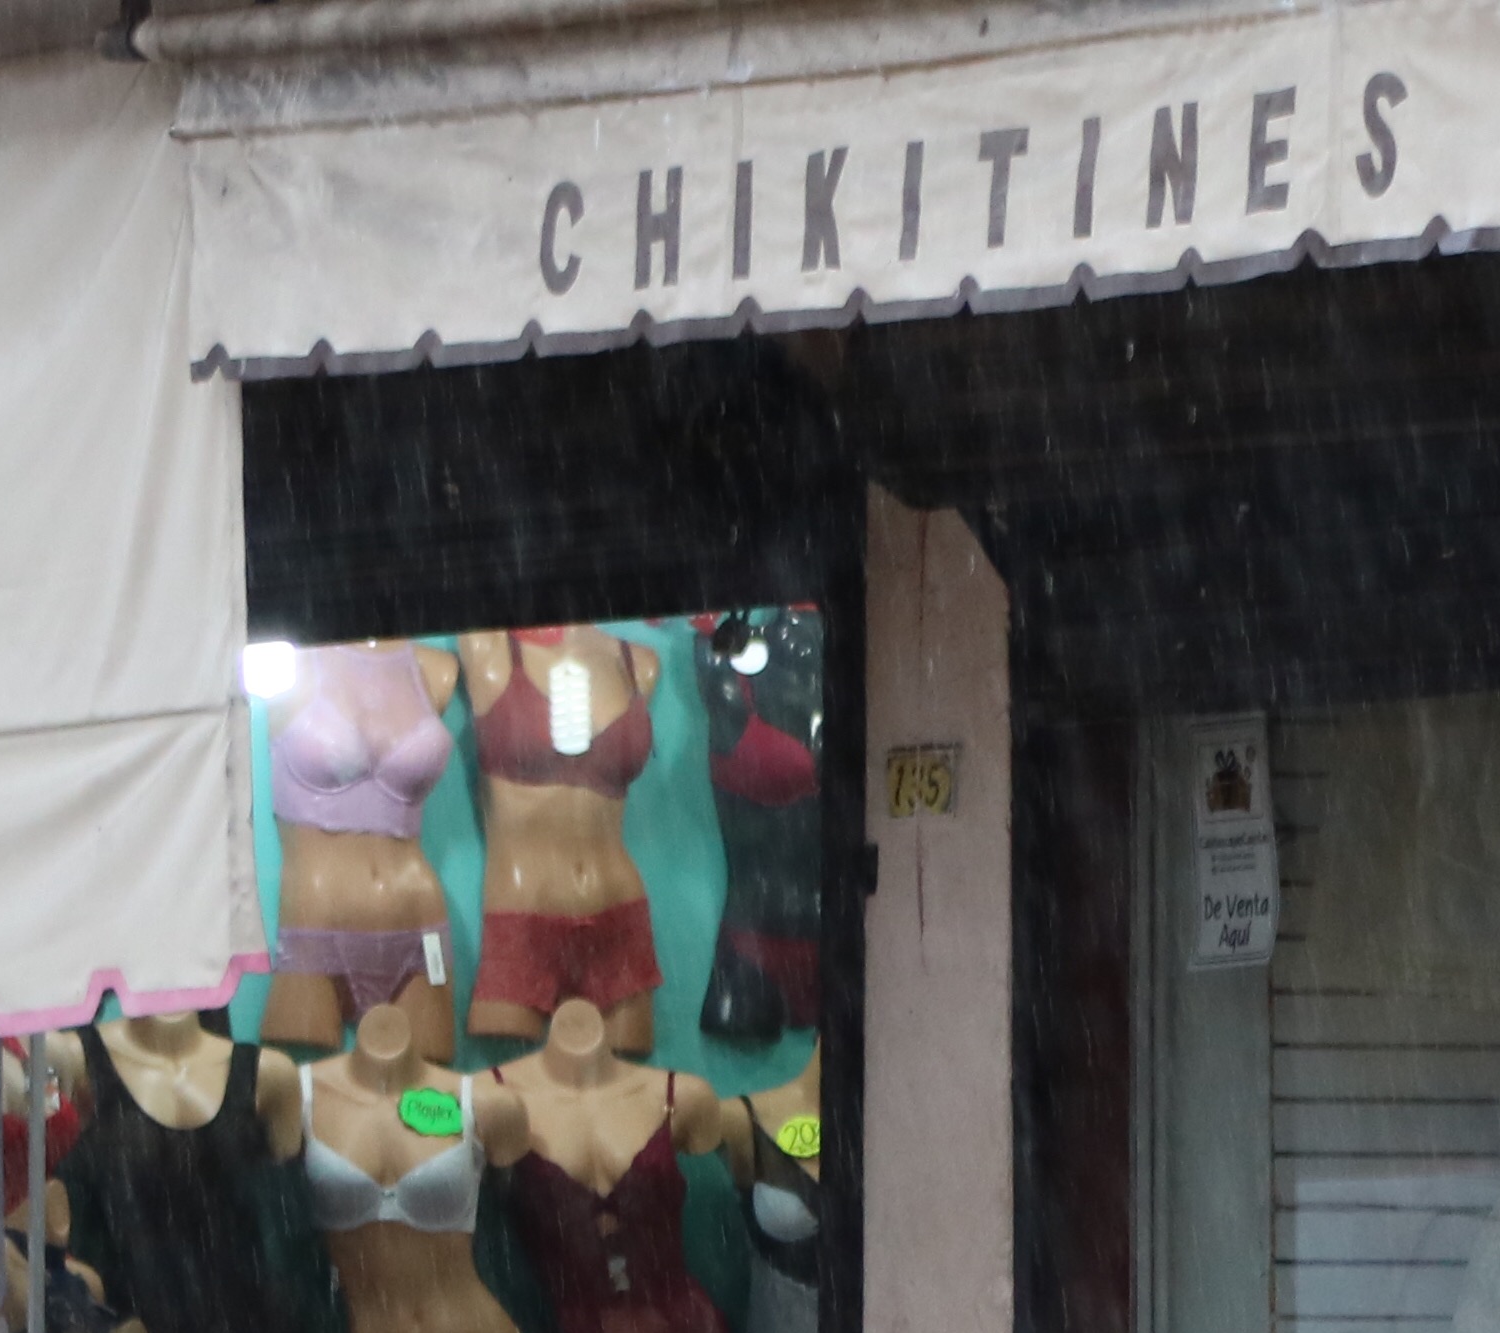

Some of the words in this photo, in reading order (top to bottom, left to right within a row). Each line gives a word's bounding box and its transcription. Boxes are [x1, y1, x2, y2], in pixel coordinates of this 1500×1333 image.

[540, 71, 1407, 296] CHIKITINES
[1204, 895, 1222, 920] De
[1226, 891, 1269, 919] Venta
